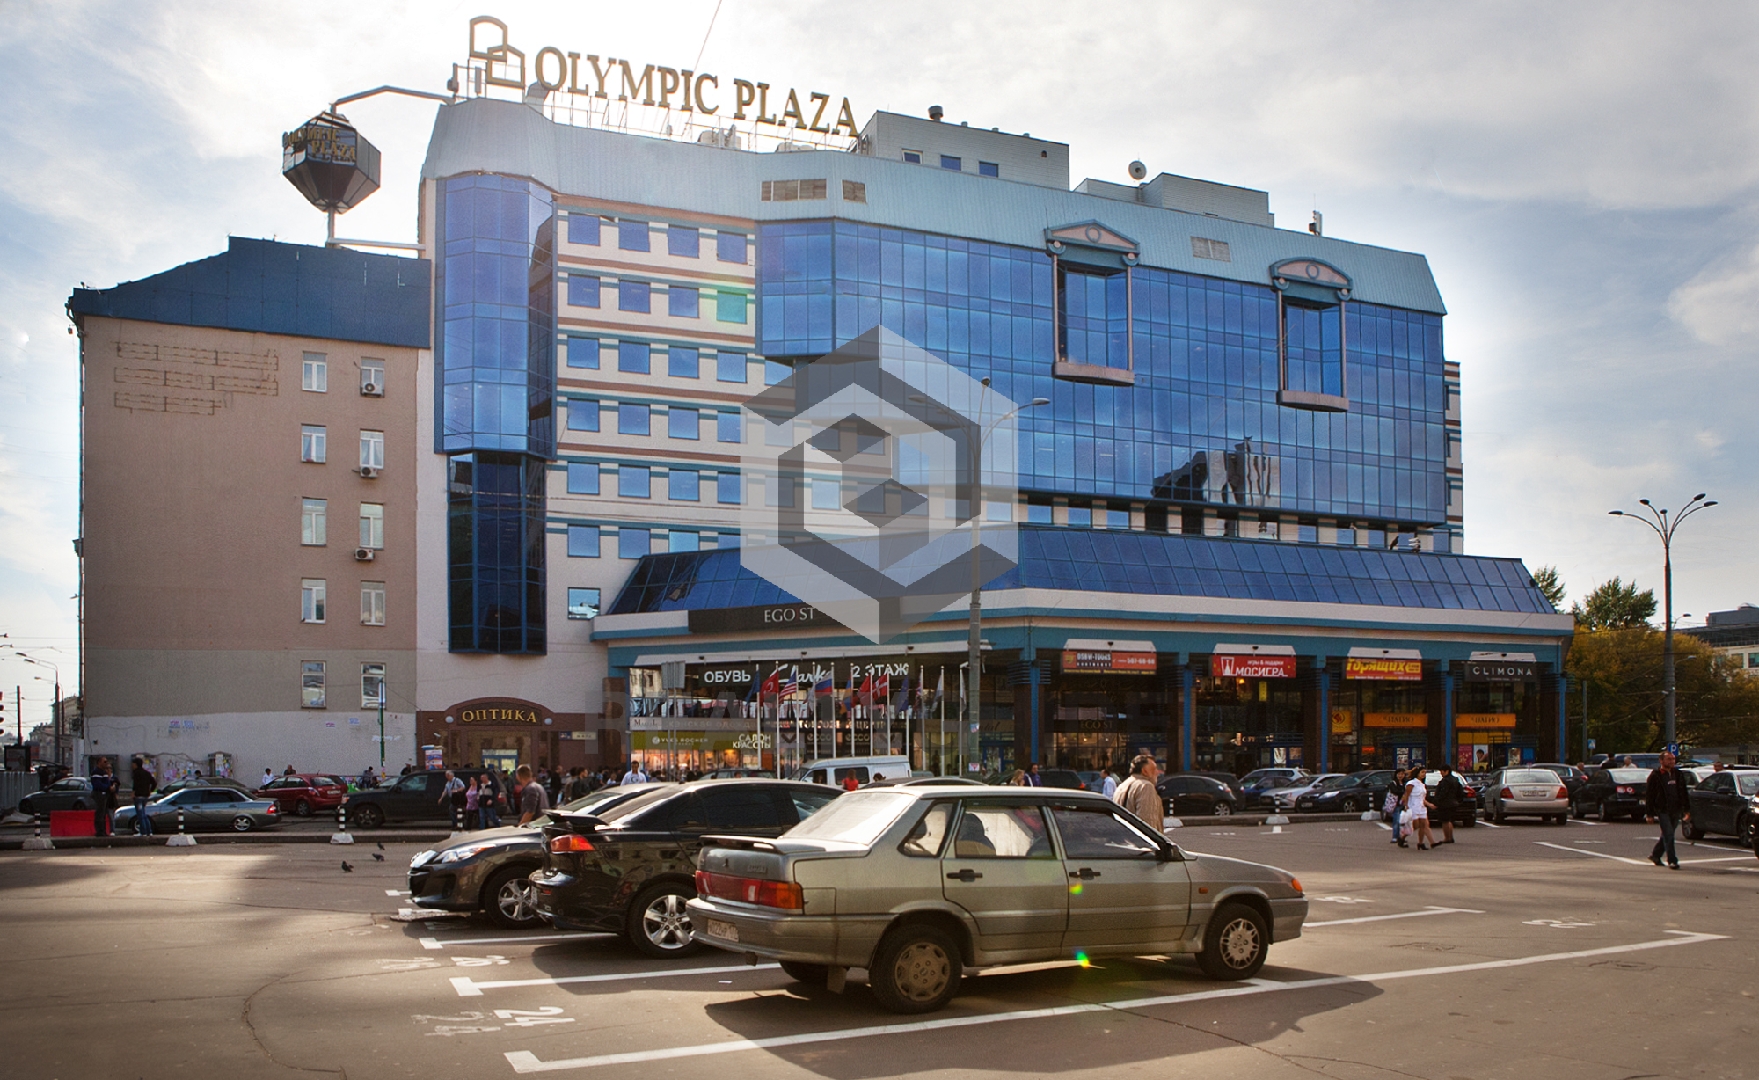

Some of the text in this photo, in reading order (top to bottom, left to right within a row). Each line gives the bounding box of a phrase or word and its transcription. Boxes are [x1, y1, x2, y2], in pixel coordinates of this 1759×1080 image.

[535, 46, 858, 137] OLYMPIC PLAZA
[311, 140, 357, 161] PLAZA
[703, 669, 752, 684] ОБУВЬ
[852, 665, 861, 678] 2
[865, 662, 909, 678] ЭТАЖ
[1236, 666, 1286, 677] МОСИГРА
[1472, 666, 1533, 676] CLIMONA
[462, 708, 537, 723] ОПТИКА
[738, 733, 771, 743] САЛОН
[806, 733, 832, 742] ecco
[845, 732, 870, 742] ecco
[732, 741, 771, 750] КРАСОТЫ
[493, 1005, 576, 1027] 24
